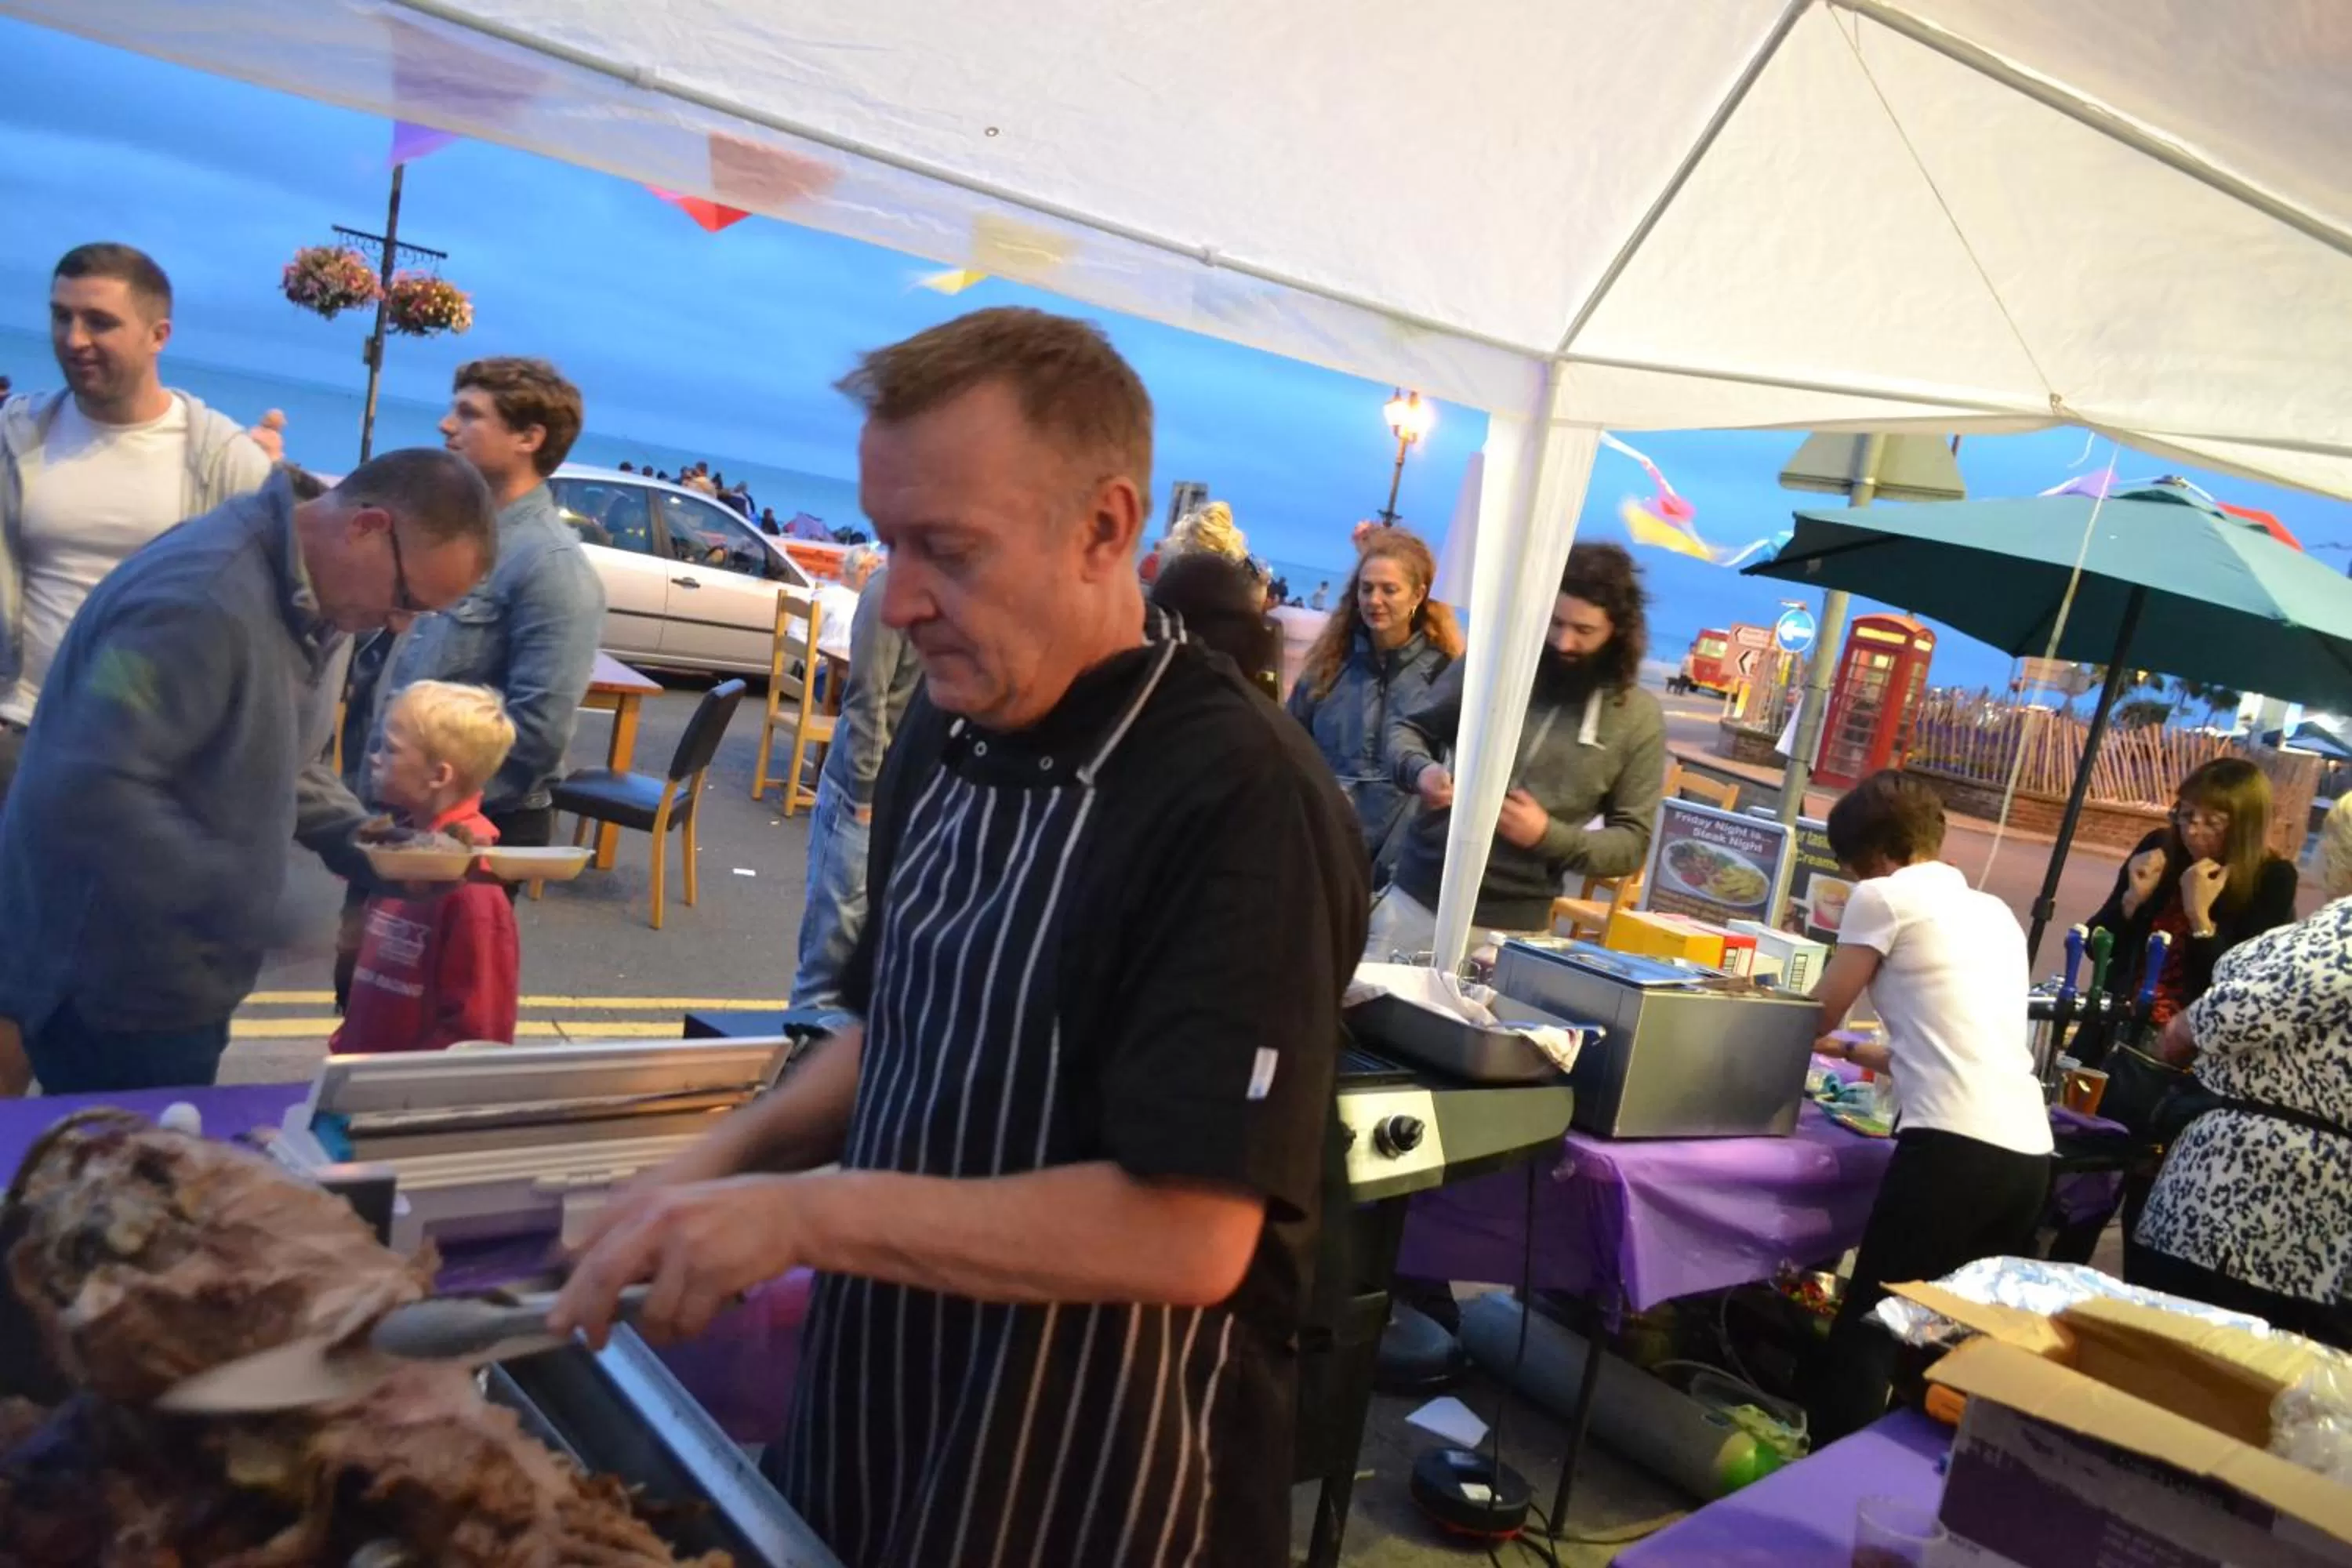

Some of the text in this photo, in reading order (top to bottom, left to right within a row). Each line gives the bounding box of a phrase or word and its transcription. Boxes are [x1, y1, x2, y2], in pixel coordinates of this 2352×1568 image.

[1674, 811, 1712, 829] Friday
[1714, 820, 1748, 837] Night
[1693, 827, 1763, 853] Steak Night
